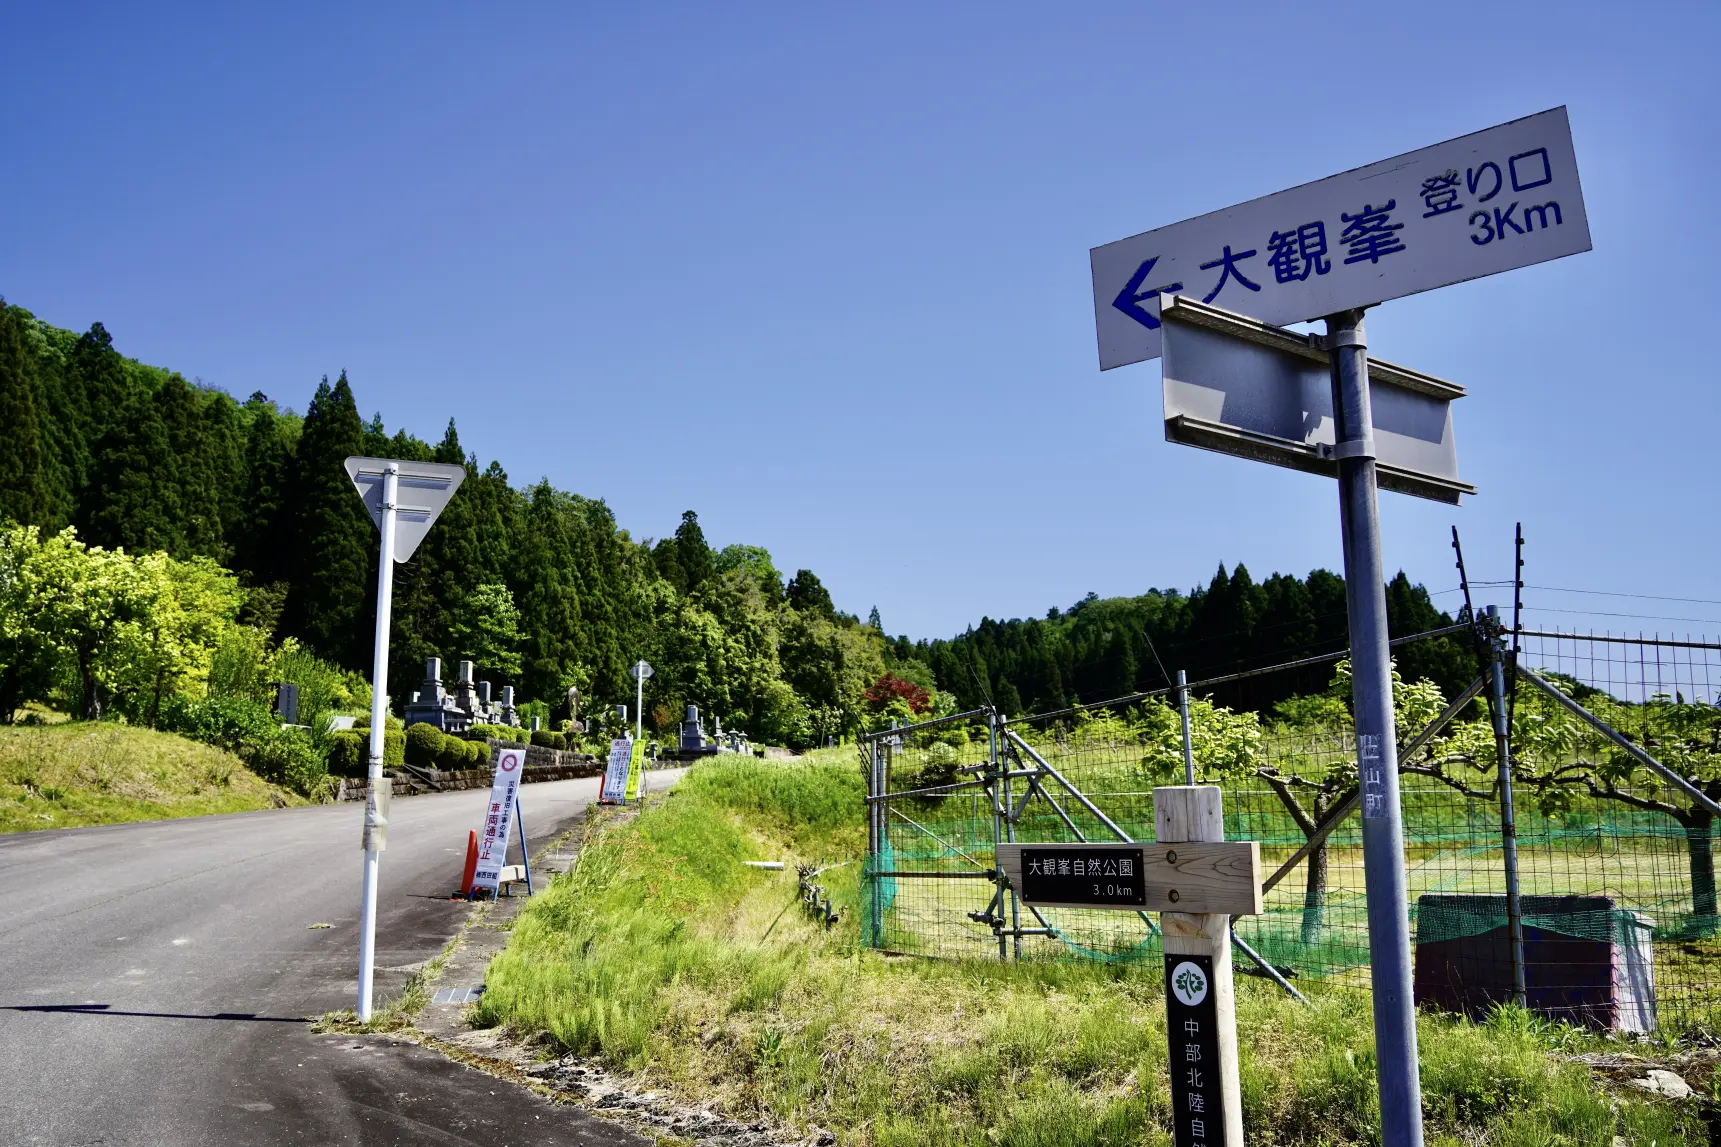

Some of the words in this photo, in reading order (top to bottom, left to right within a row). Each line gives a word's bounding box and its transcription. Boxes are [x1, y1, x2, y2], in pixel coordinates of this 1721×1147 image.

[1200, 198, 1406, 304] 大観峯
[1419, 147, 1553, 219] 登り口
[1468, 200, 1563, 246] 3Km
[480, 803, 501, 860] 車両通行止
[498, 780, 515, 839] 災害復旧工事の為
[1028, 858, 1134, 877] 大観峯自然公園
[1184, 1018, 1207, 1147] 中部北陸自
